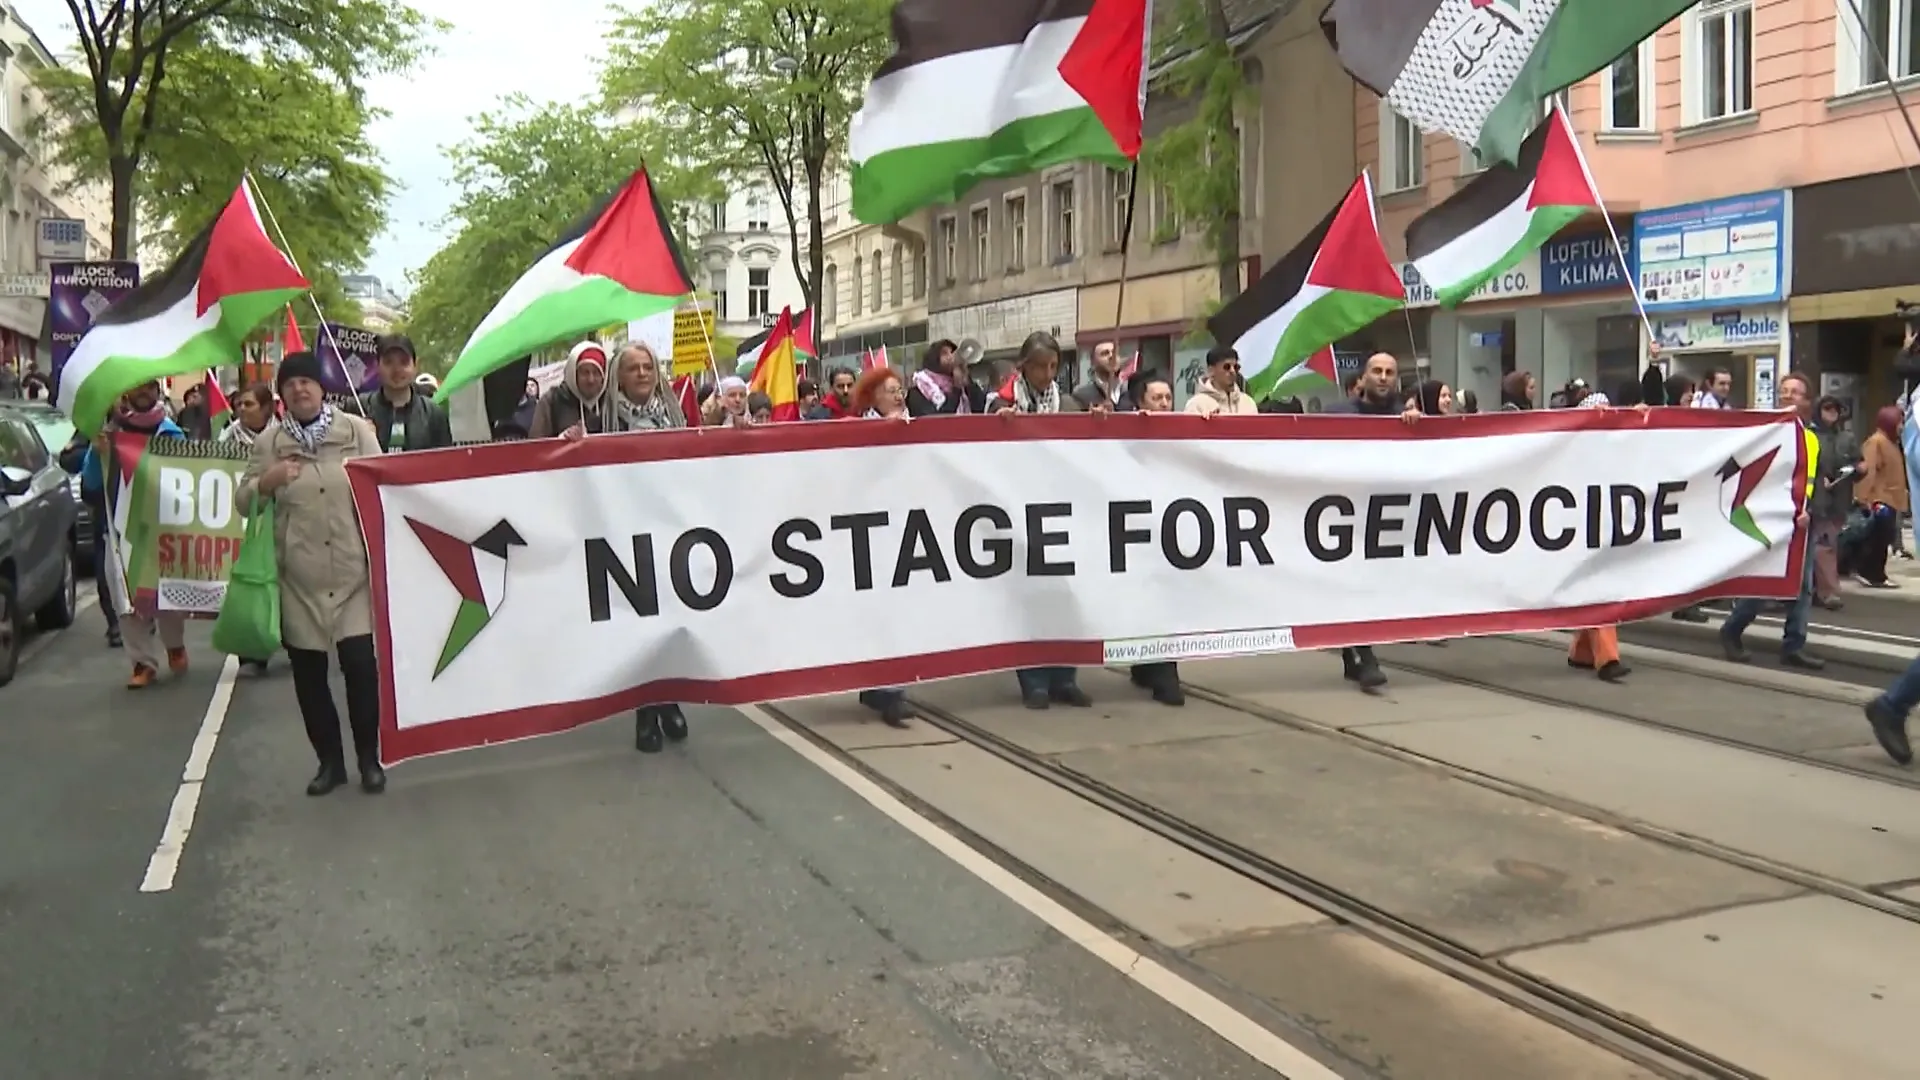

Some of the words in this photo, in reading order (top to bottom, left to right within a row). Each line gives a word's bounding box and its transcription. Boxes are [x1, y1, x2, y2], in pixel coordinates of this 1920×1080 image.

[73, 266, 116, 277] BLOCK
[1559, 260, 1619, 286] KLIMA
[54, 275, 133, 288] EUROVISION
[1504, 272, 1529, 291] CO.
[338, 328, 376, 343] BLOCK
[585, 528, 734, 622] NO
[770, 501, 1075, 598] STAGE
[1109, 498, 1275, 573] FOR
[1305, 481, 1688, 562] GENOCIDE
